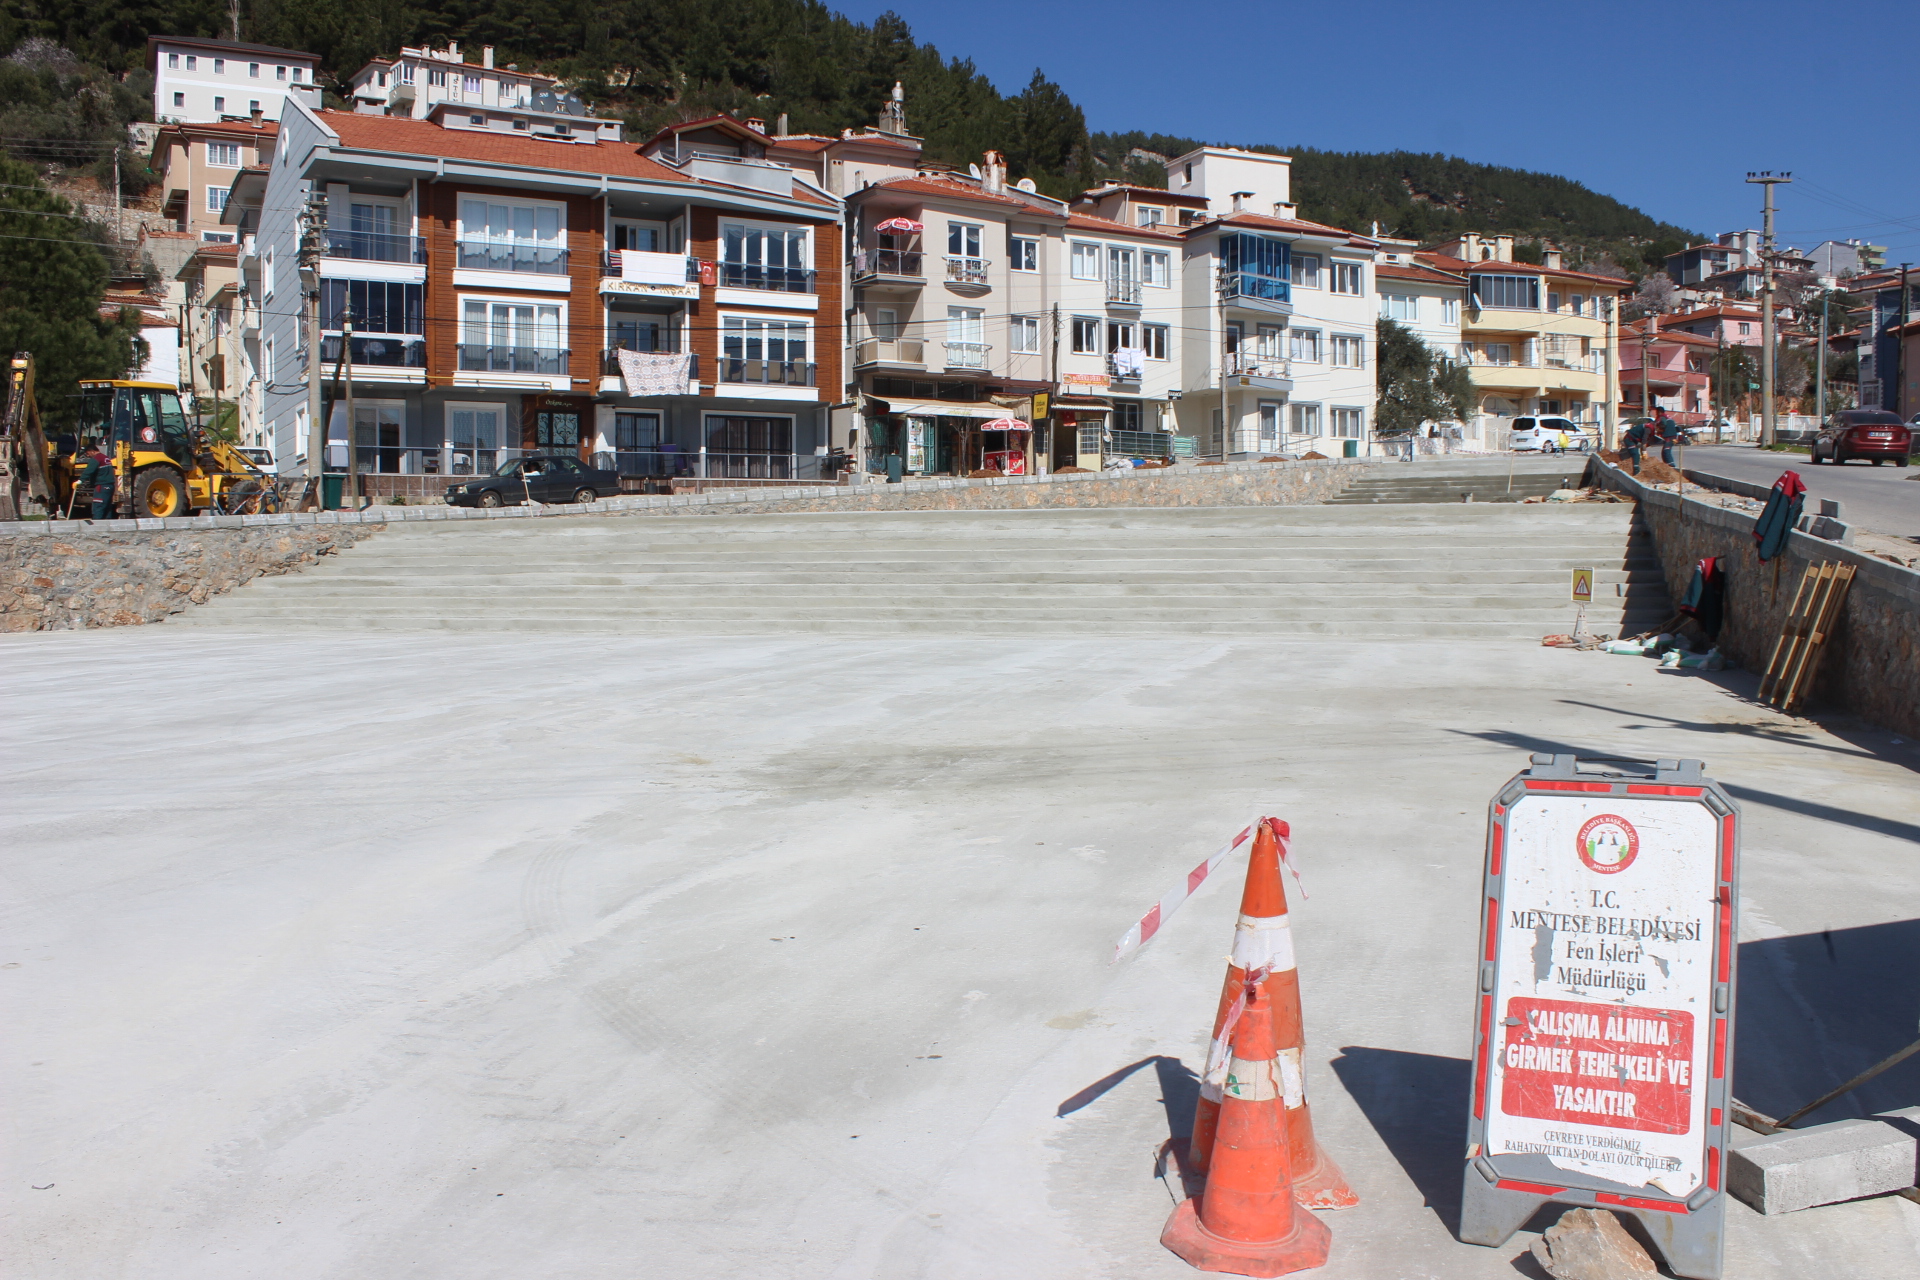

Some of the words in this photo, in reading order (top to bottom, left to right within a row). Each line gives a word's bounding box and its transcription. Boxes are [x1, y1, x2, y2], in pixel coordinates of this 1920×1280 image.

[1580, 817, 1605, 840] BELEDİYE
[1605, 817, 1636, 843] BAŞKANLIĞI
[1592, 863, 1621, 872] MENTEŞE
[1590, 889, 1620, 909] T.C.
[1510, 911, 1591, 937] MENTEŞE
[1596, 915, 1701, 941] BELEDİYESİ
[1566, 940, 1594, 960] Fen
[1600, 939, 1640, 966] İşleri
[1557, 966, 1646, 996] Müdürlüğü
[1528, 1009, 1601, 1045] ÇALIŞMA
[1604, 1016, 1670, 1046] ALNINA
[1506, 1037, 1574, 1074] GİRMEK
[1577, 1046, 1662, 1083] TEHLİKELİ
[1667, 1059, 1690, 1086] VE
[1553, 1084, 1636, 1118] YASAKTIR
[1543, 1130, 1584, 1145] ÇEVREYE
[1586, 1135, 1642, 1152] VERDİĞİMİZ
[1582, 1150, 1616, 1163] DOLAYI
[1617, 1152, 1642, 1167] ÖZÜR
